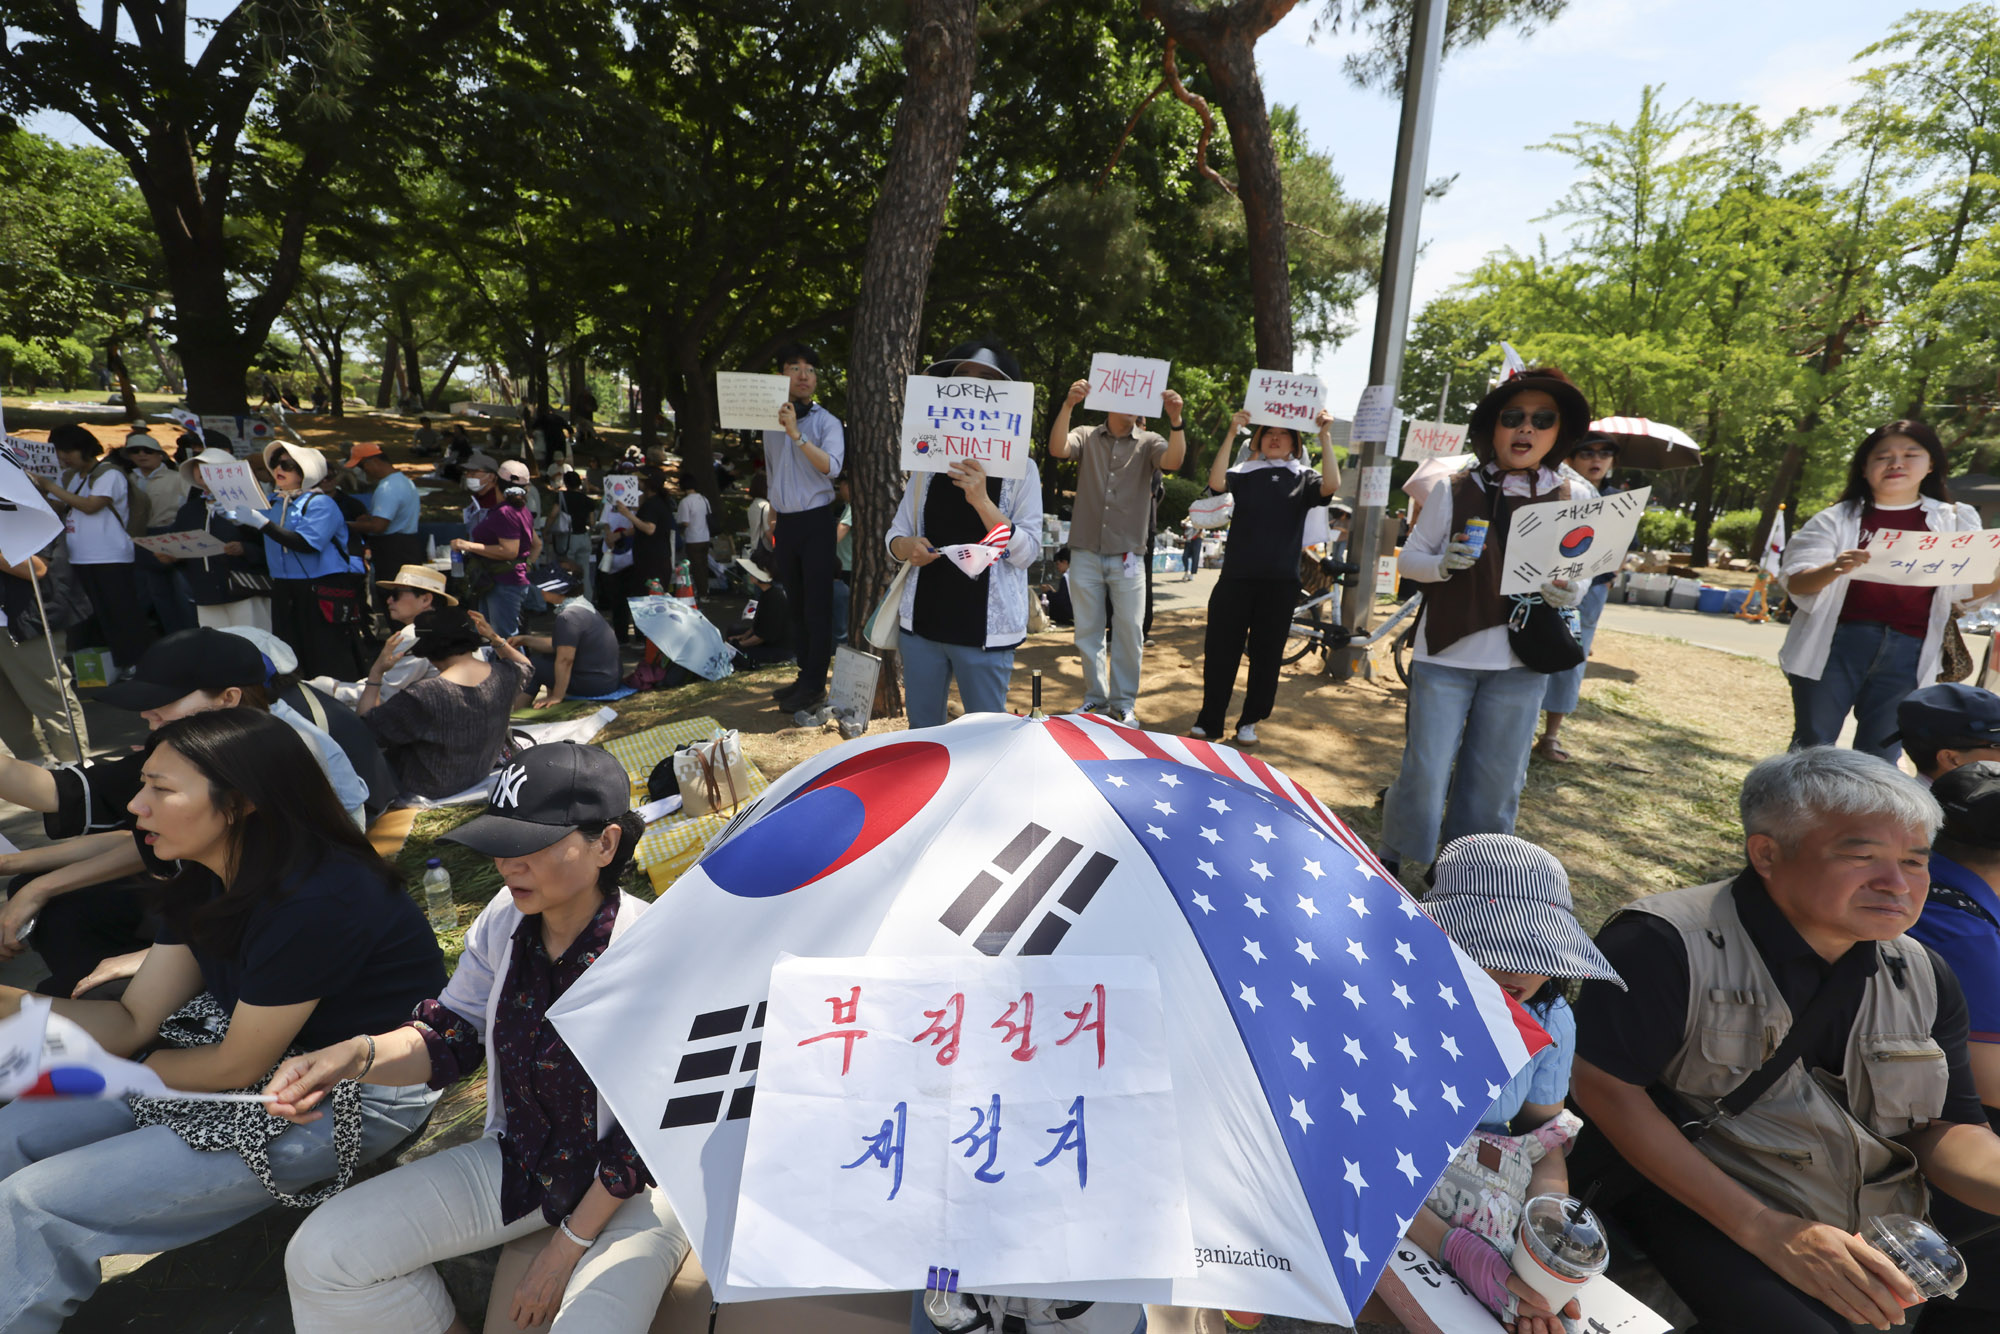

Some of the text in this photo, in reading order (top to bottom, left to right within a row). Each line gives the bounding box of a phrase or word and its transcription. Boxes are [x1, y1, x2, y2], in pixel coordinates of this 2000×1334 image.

[937, 384, 1008, 403] KOREA
[1097, 368, 1155, 399] 재선거
[1259, 377, 1318, 398] 부정선거
[928, 405, 1022, 437] 부정선거
[943, 435, 1011, 461] 재선거
[1413, 428, 1460, 452] 재선거
[1554, 500, 1604, 521] 재선거
[1547, 562, 1584, 580] 수개표
[1890, 557, 1970, 576] 재선거
[797, 984, 1105, 1077] 부정선거
